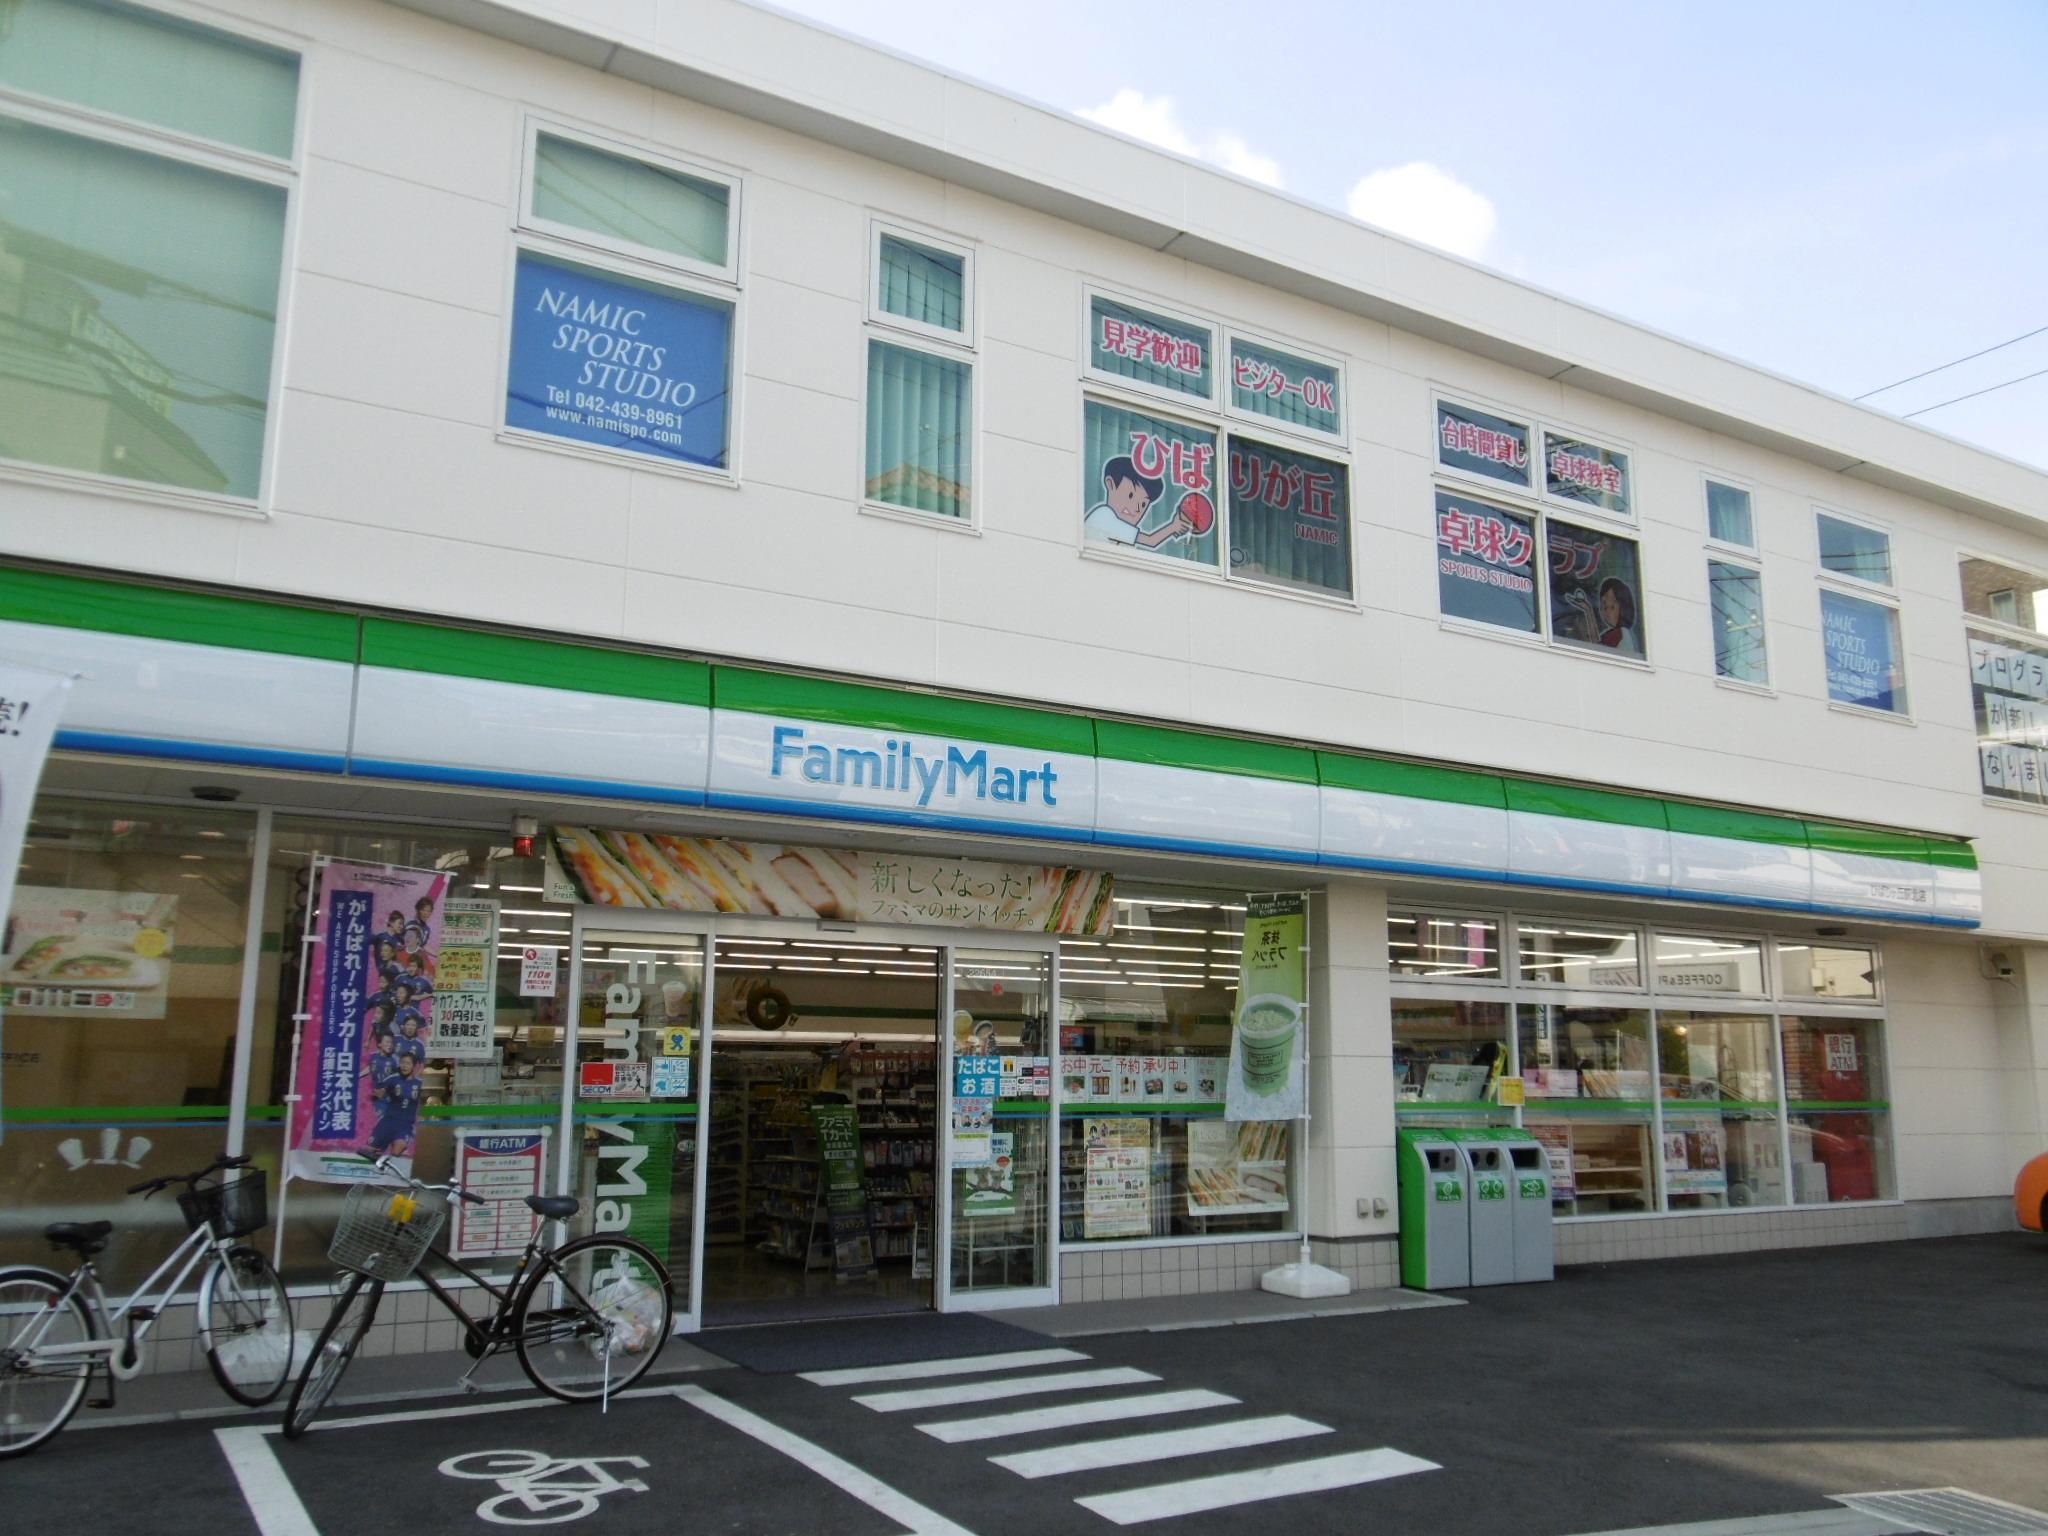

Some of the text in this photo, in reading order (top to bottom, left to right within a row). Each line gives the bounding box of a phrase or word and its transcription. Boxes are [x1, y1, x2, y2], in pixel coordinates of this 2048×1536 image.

[535, 287, 646, 336] NAMIC
[553, 324, 666, 372] SPORTS
[1102, 316, 1201, 376] 見学歓迎
[578, 360, 696, 407] STUDIO
[1233, 357, 1334, 412] ビジターOK
[546, 385, 682, 430] Tel 042-439-8961
[546, 405, 682, 446] www.namispo.com
[1440, 418, 1528, 468] 台時間貸し
[1552, 452, 1622, 496] 卓球教室
[1295, 522, 1338, 546] NAMIC
[1440, 559, 1533, 593] SPORTS STUDIO
[1825, 630, 1866, 655] SPORTS
[1837, 651, 1880, 676] STUDIO
[771, 724, 1058, 808] FamilyMart
[553, 882, 569, 892] Fun
[553, 890, 575, 900] Fresh
[871, 899, 1035, 927] ファミマのサンドイッチ。
[440, 1010, 485, 1022] 30円引き
[1828, 1035, 1853, 1054] 銀行
[958, 1058, 1000, 1075] たばこ
[1830, 1055, 1853, 1070] ATM
[582, 1086, 611, 1094] SECOM
[961, 1077, 996, 1095] お酒
[479, 1138, 527, 1150] 銀行ATM
